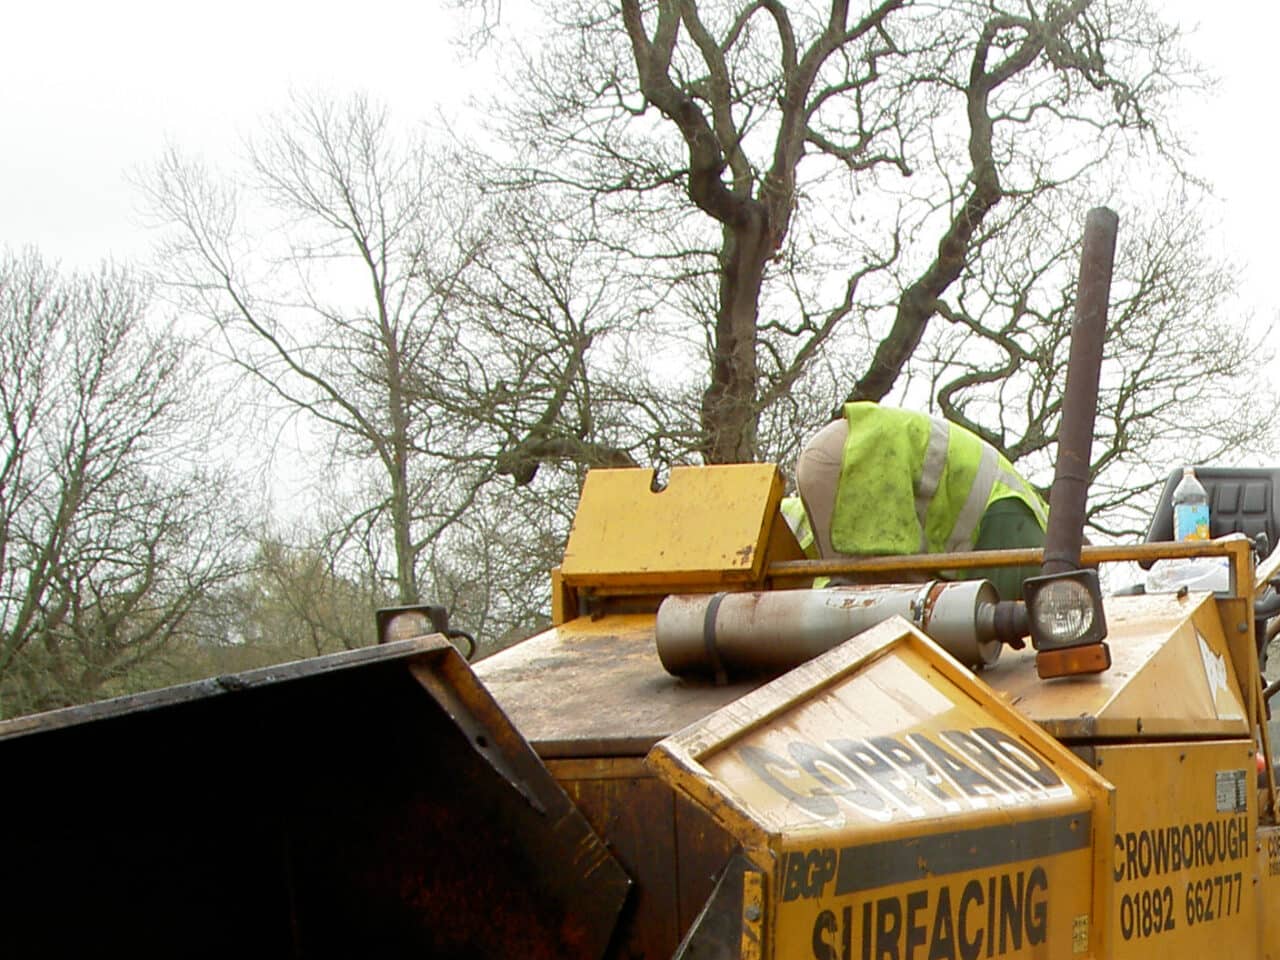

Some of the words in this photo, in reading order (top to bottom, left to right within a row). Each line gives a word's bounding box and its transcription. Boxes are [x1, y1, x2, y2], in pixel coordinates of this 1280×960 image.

[738, 727, 1073, 829] COPPARD
[1113, 816, 1249, 882] CROWBOROUGH
[1120, 886, 1176, 941] 01892
[1186, 871, 1242, 926] 662777
